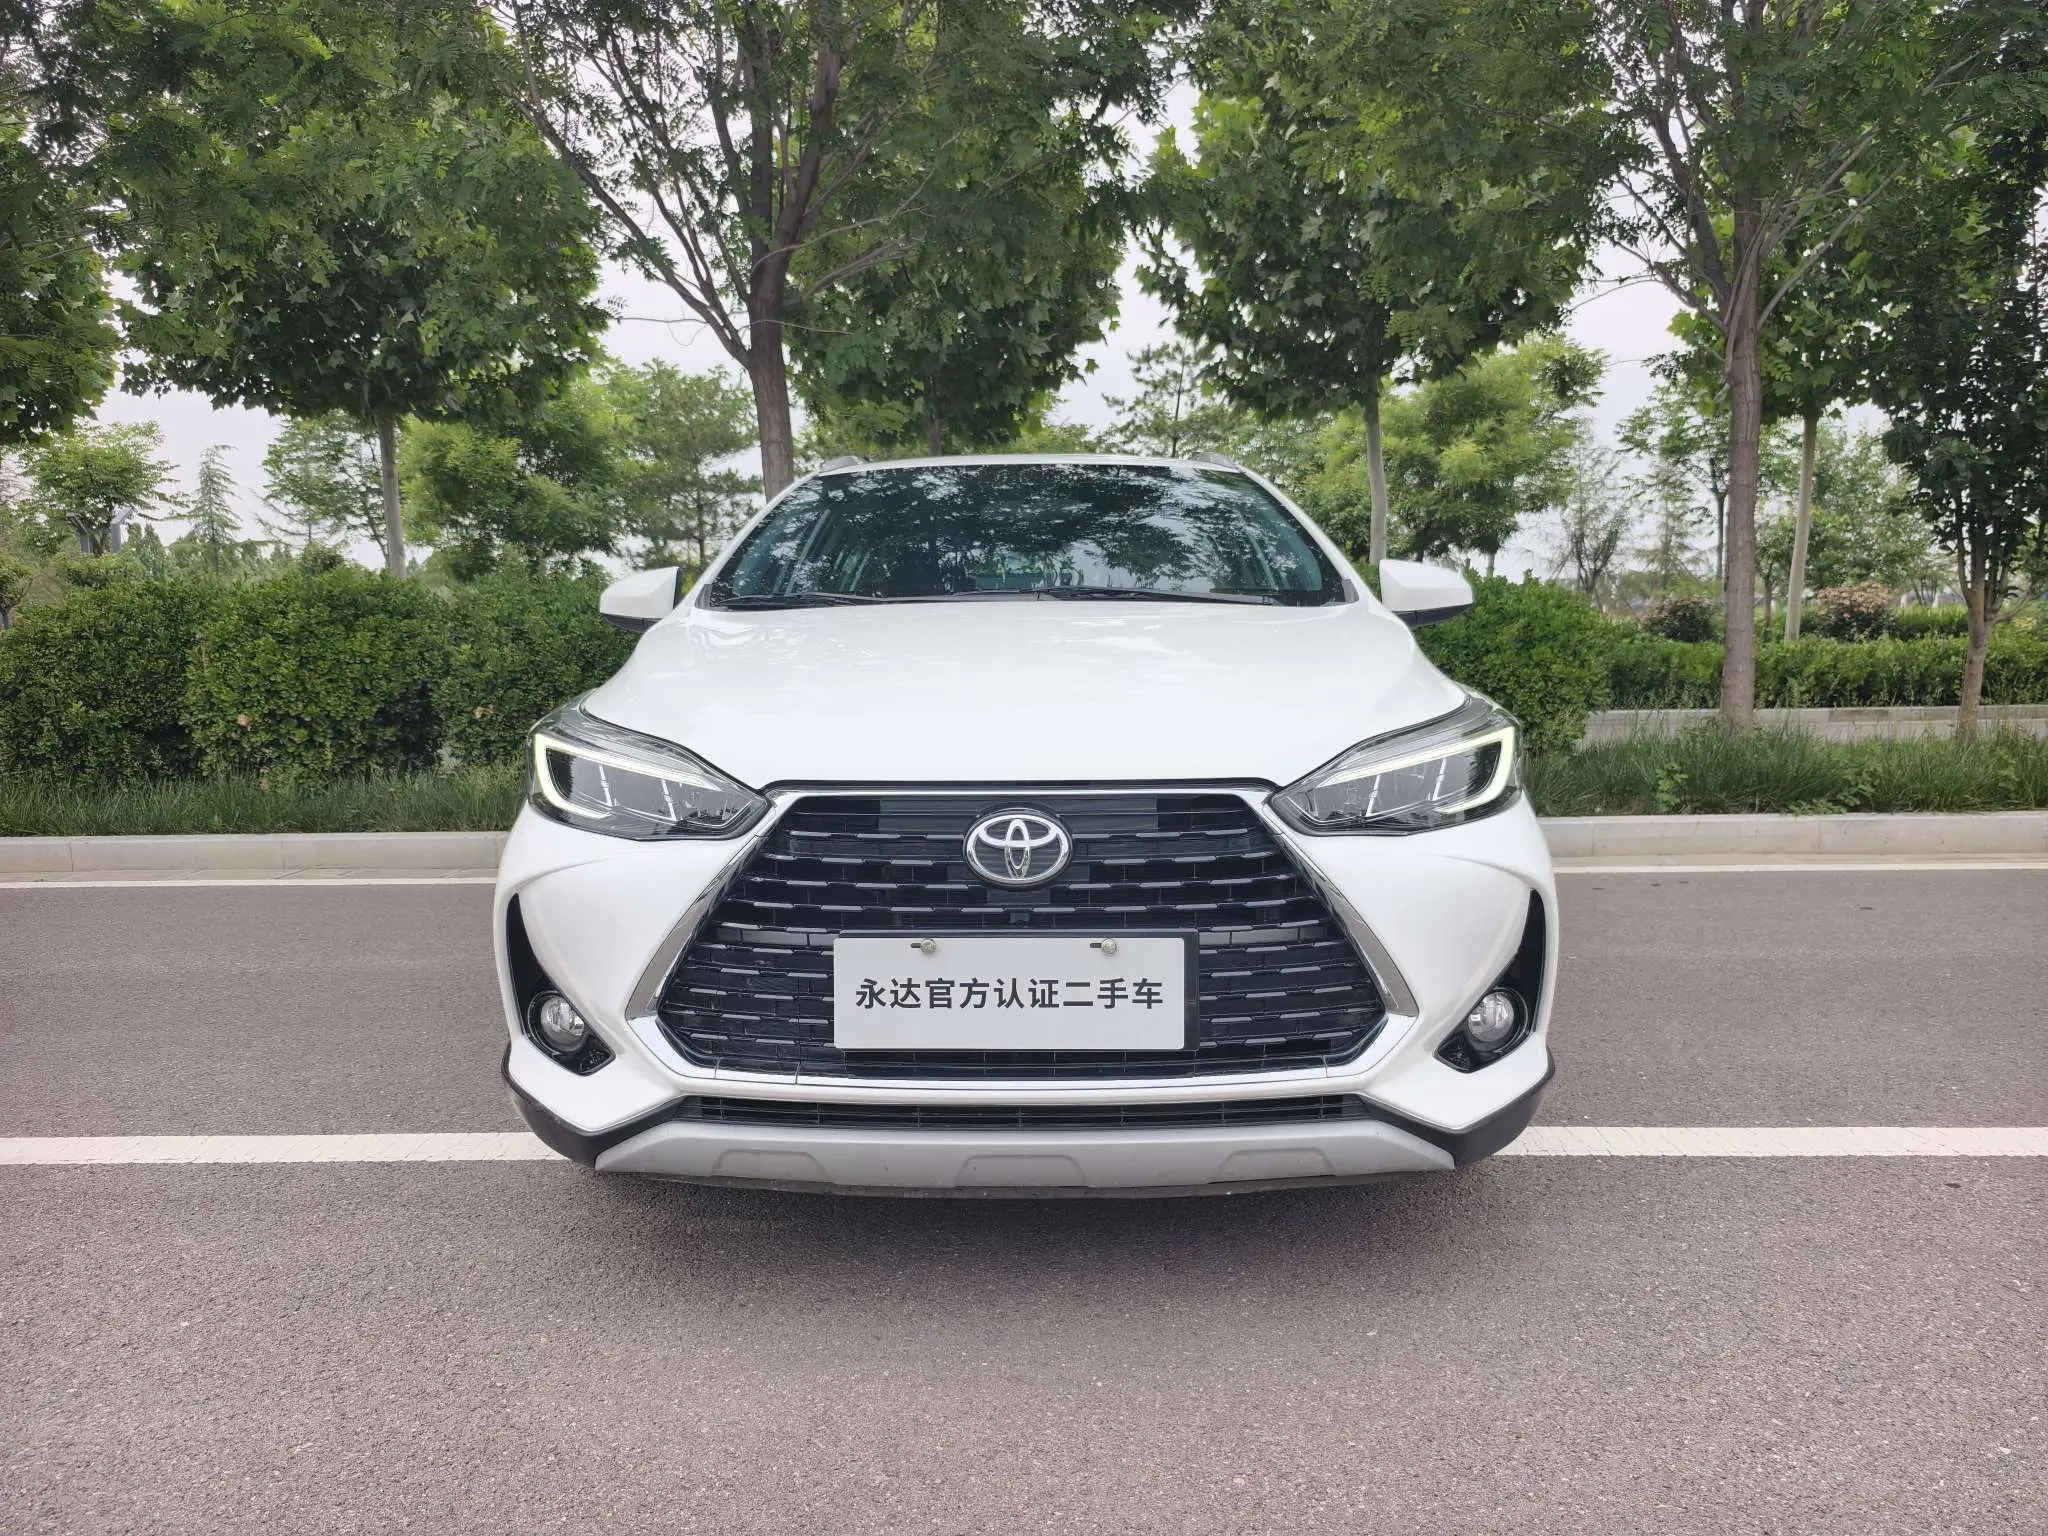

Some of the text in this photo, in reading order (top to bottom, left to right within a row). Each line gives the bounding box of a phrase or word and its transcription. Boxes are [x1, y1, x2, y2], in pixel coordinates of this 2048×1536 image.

[855, 977, 1163, 1009] 永达官方认证二手车
